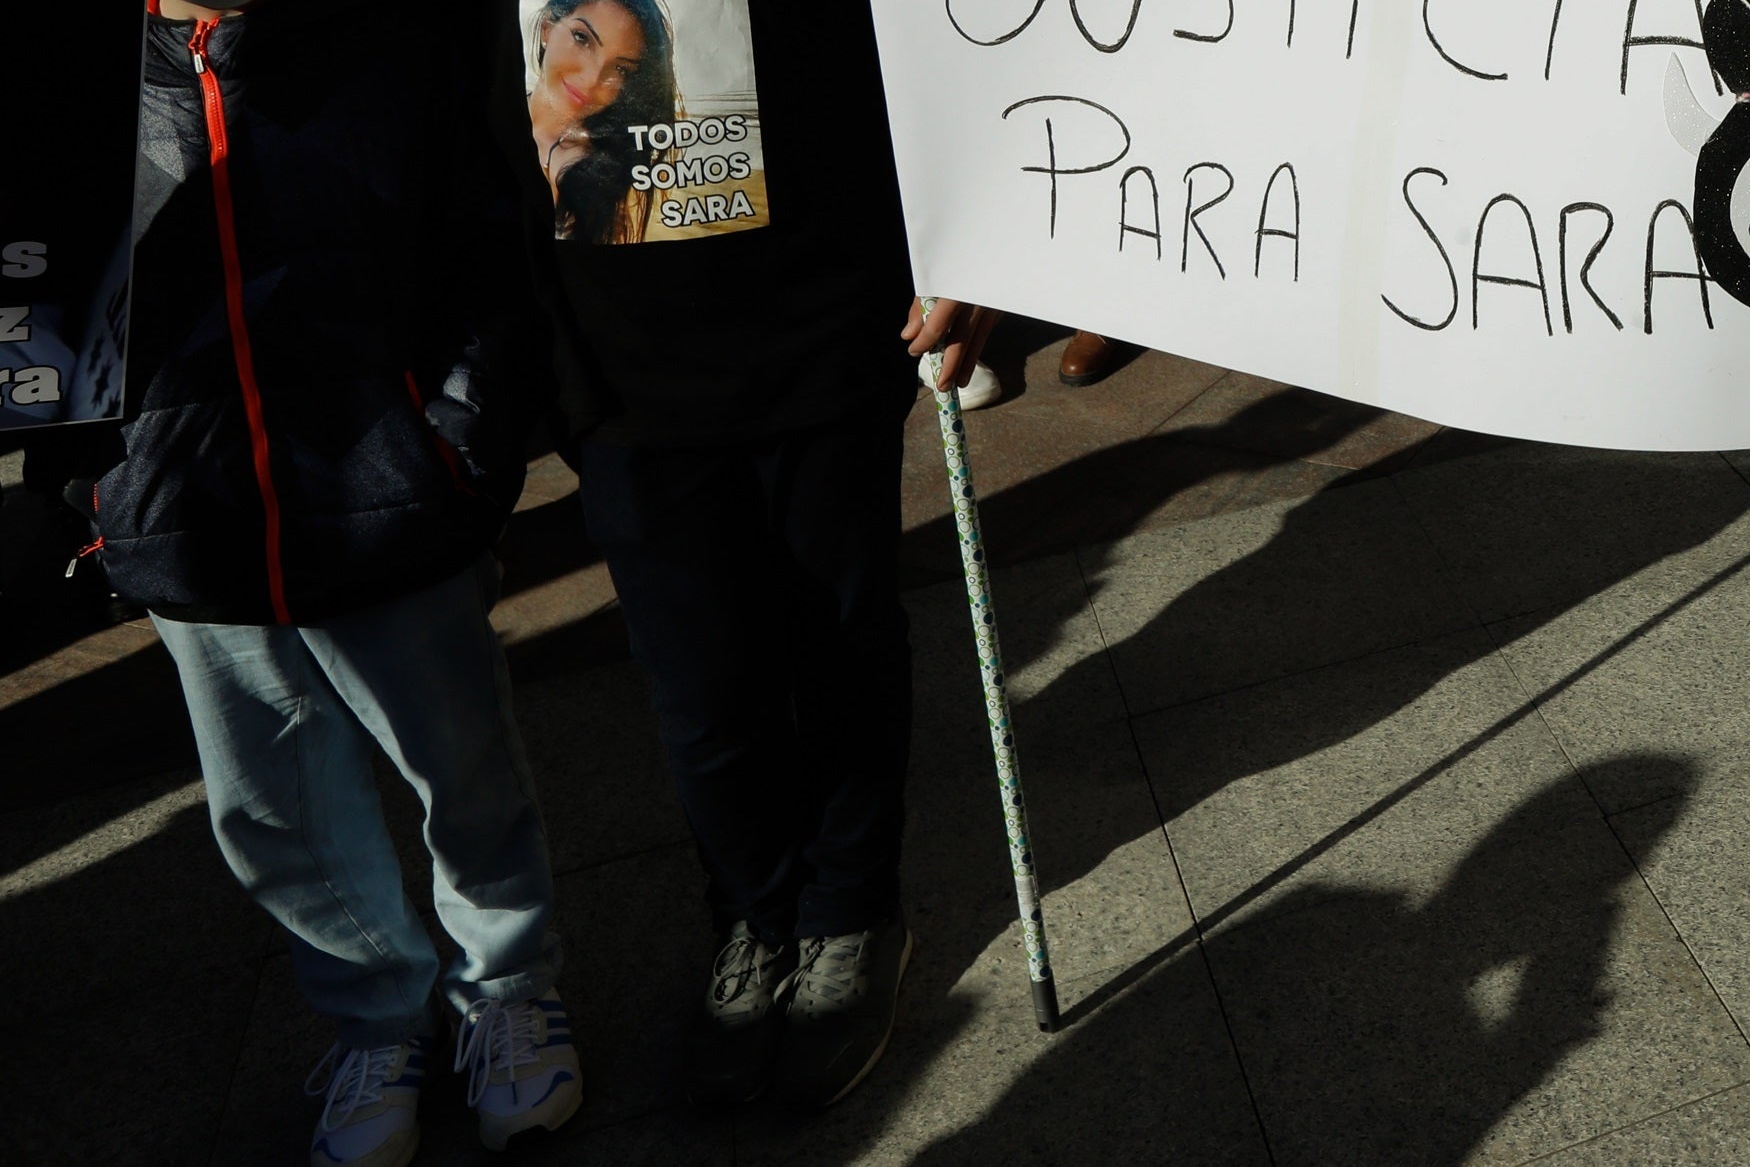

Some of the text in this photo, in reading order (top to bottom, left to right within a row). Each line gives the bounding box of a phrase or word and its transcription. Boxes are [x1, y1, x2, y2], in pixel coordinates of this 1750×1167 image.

[627, 114, 748, 152] TODOS
[631, 152, 752, 192] SOMOS
[661, 190, 757, 228] SARA
[1001, 93, 1717, 337] PARA SARA
